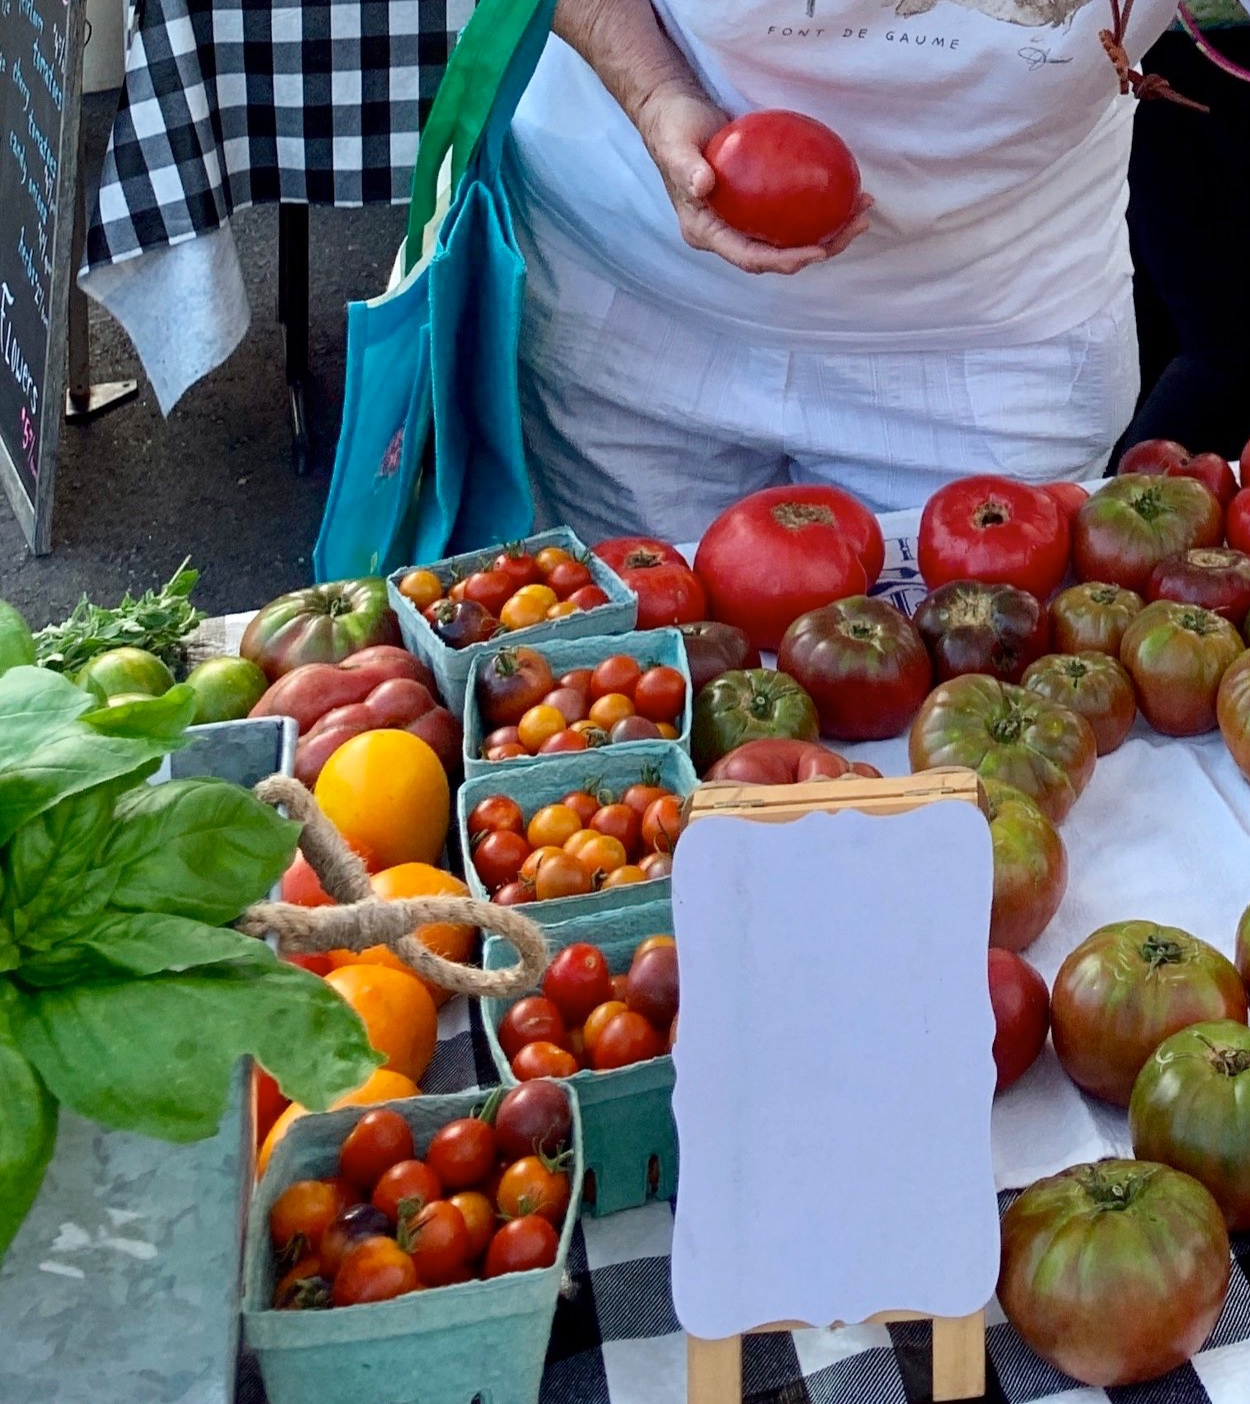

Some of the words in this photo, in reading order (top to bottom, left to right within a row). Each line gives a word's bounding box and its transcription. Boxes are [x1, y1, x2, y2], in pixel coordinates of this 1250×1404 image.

[767, 26, 825, 38] FONT
[842, 28, 868, 39] DE
[885, 30, 960, 50] GAUME
